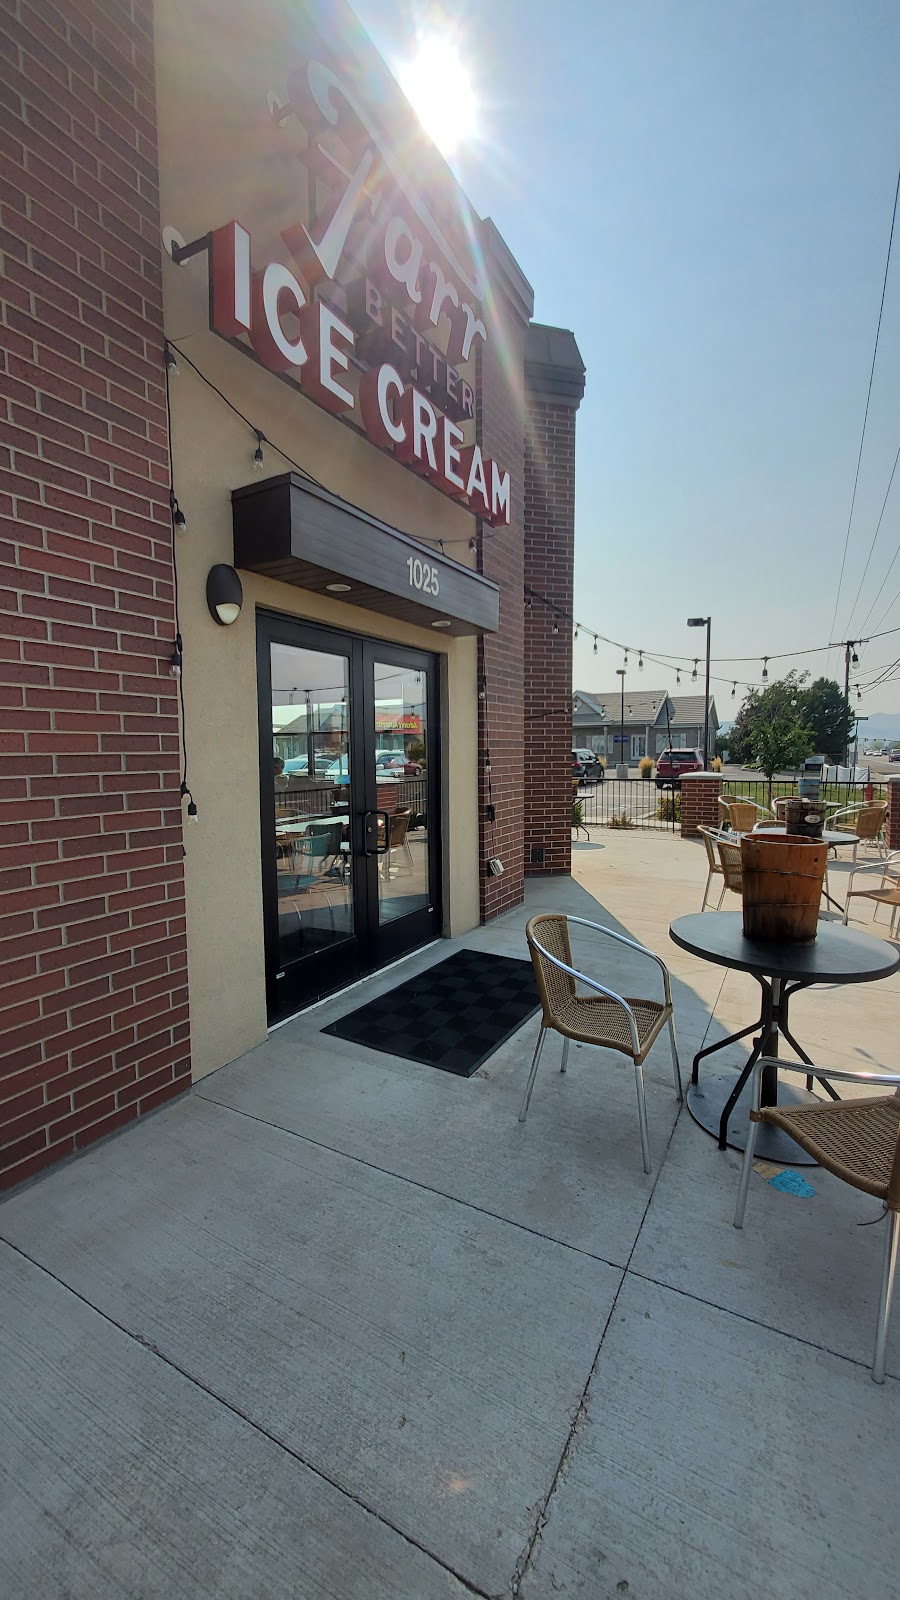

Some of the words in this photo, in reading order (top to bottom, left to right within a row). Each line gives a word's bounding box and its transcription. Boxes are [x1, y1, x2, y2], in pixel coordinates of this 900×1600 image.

[301, 60, 487, 361] Farr
[234, 220, 355, 410] ICE
[377, 363, 511, 524] CREAM
[365, 277, 474, 418] BETTER
[406, 556, 440, 597] 1025
